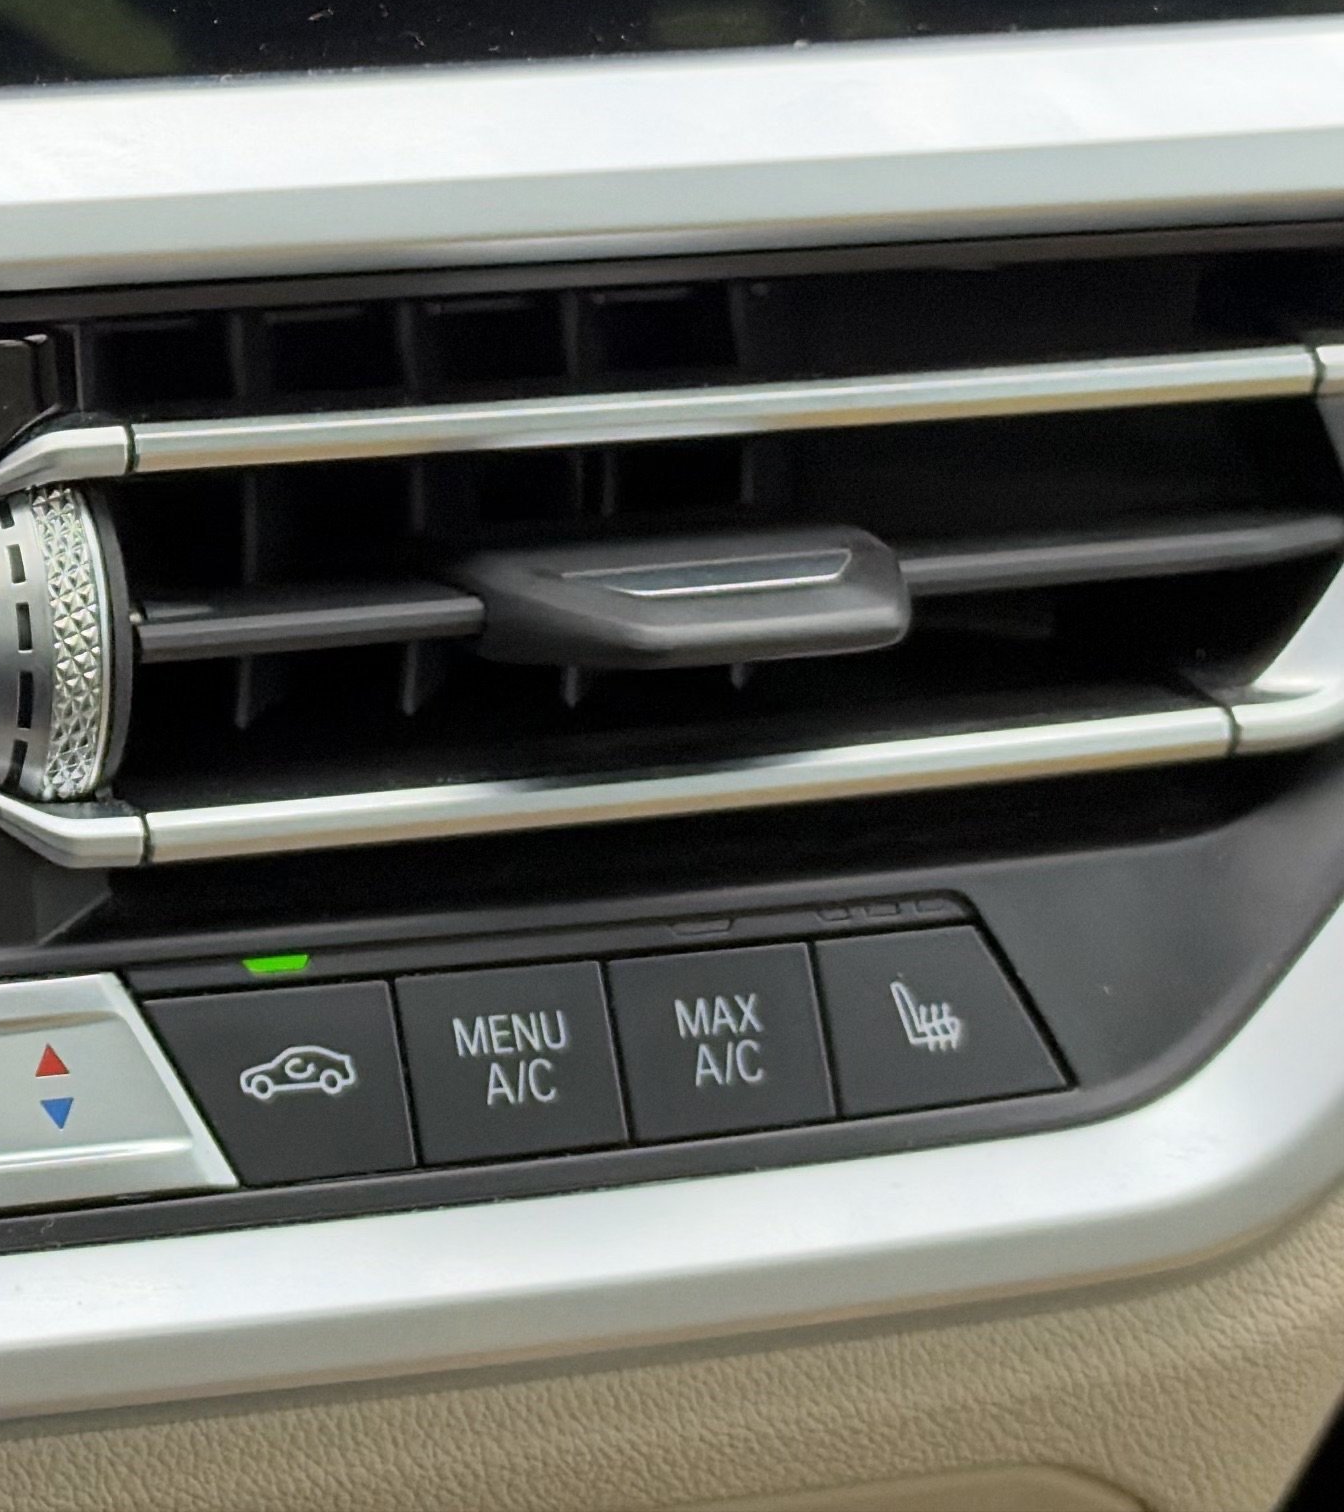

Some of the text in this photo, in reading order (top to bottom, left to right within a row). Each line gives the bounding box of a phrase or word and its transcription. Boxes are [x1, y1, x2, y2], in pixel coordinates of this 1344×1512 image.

[453, 1011, 567, 1058] MENU
[676, 993, 761, 1038] MAX
[487, 1061, 557, 1105] A/C
[695, 1041, 764, 1085] A/C
